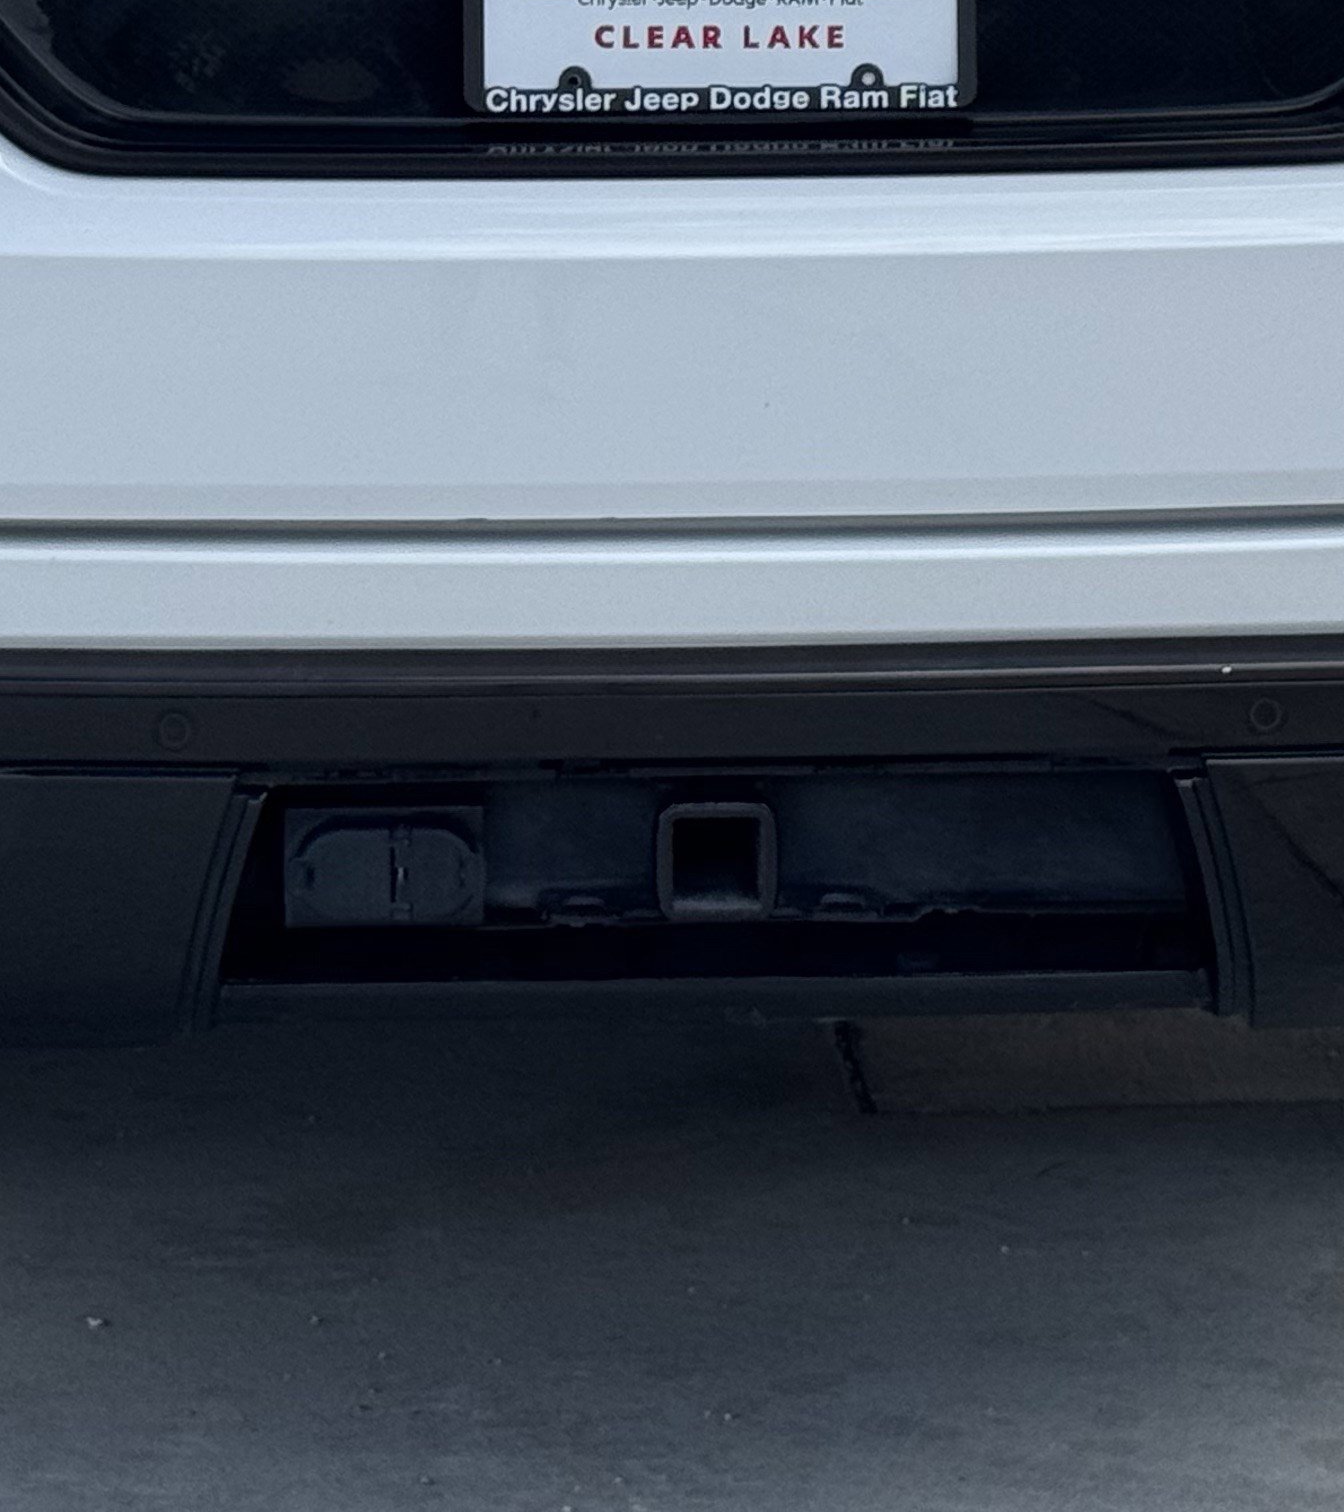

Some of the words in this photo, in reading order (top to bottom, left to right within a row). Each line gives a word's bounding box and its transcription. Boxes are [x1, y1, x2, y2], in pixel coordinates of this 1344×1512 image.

[594, 25, 722, 50] CLEAR
[743, 25, 845, 49] LAKE
[485, 88, 616, 114] Chrysler
[624, 87, 699, 111] Jeep
[709, 86, 810, 110] Dodge
[820, 86, 889, 109] Ram
[900, 84, 959, 108] Fiat
